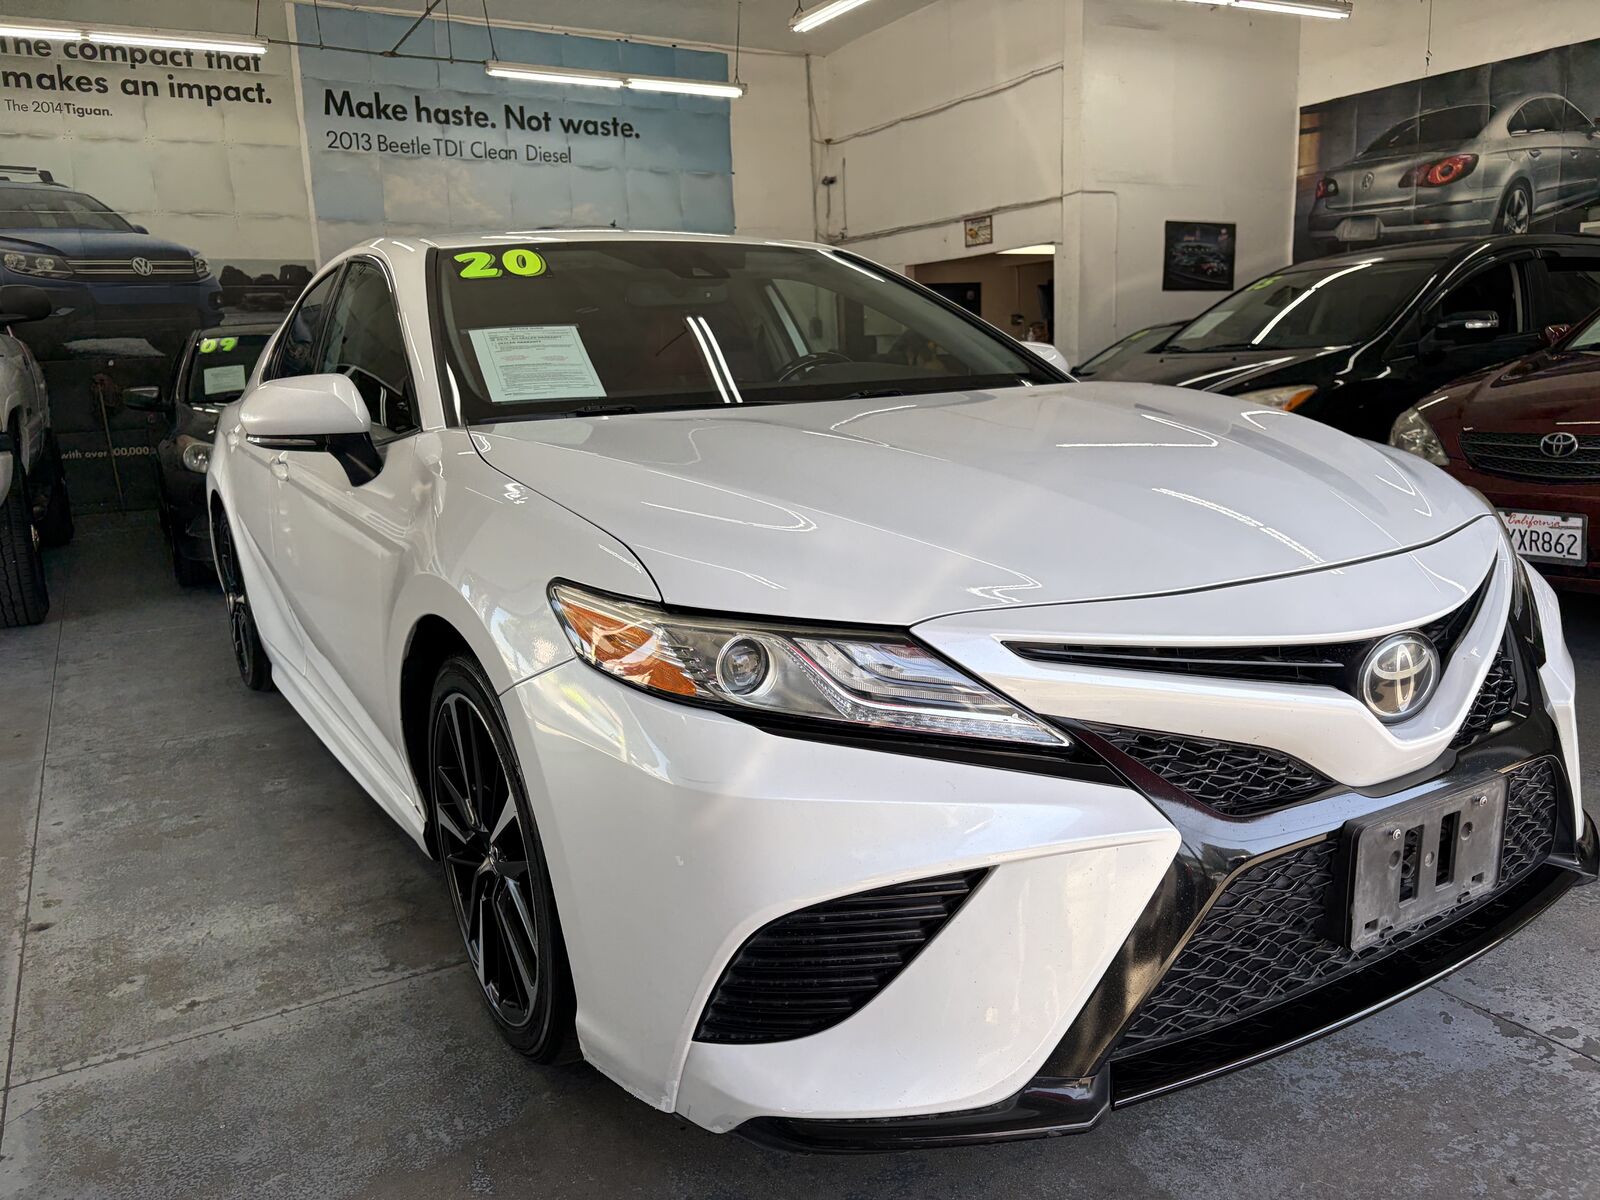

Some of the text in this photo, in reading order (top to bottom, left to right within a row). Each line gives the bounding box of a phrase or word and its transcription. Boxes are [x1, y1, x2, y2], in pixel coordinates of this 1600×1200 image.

[63, 40, 194, 70] compact
[204, 49, 261, 72] that
[1, 64, 272, 107] makes an impact.
[4, 99, 113, 118] The 2014 Tiguan.
[324, 88, 641, 139] Make haste. Not waste.
[326, 130, 572, 164] 2013 Beetle TDI Clean Diesel
[453, 249, 547, 279] 20
[200, 337, 238, 353] 09
[61, 449, 83, 460] with
[85, 450, 107, 459] over
[1507, 514, 1561, 529] California
